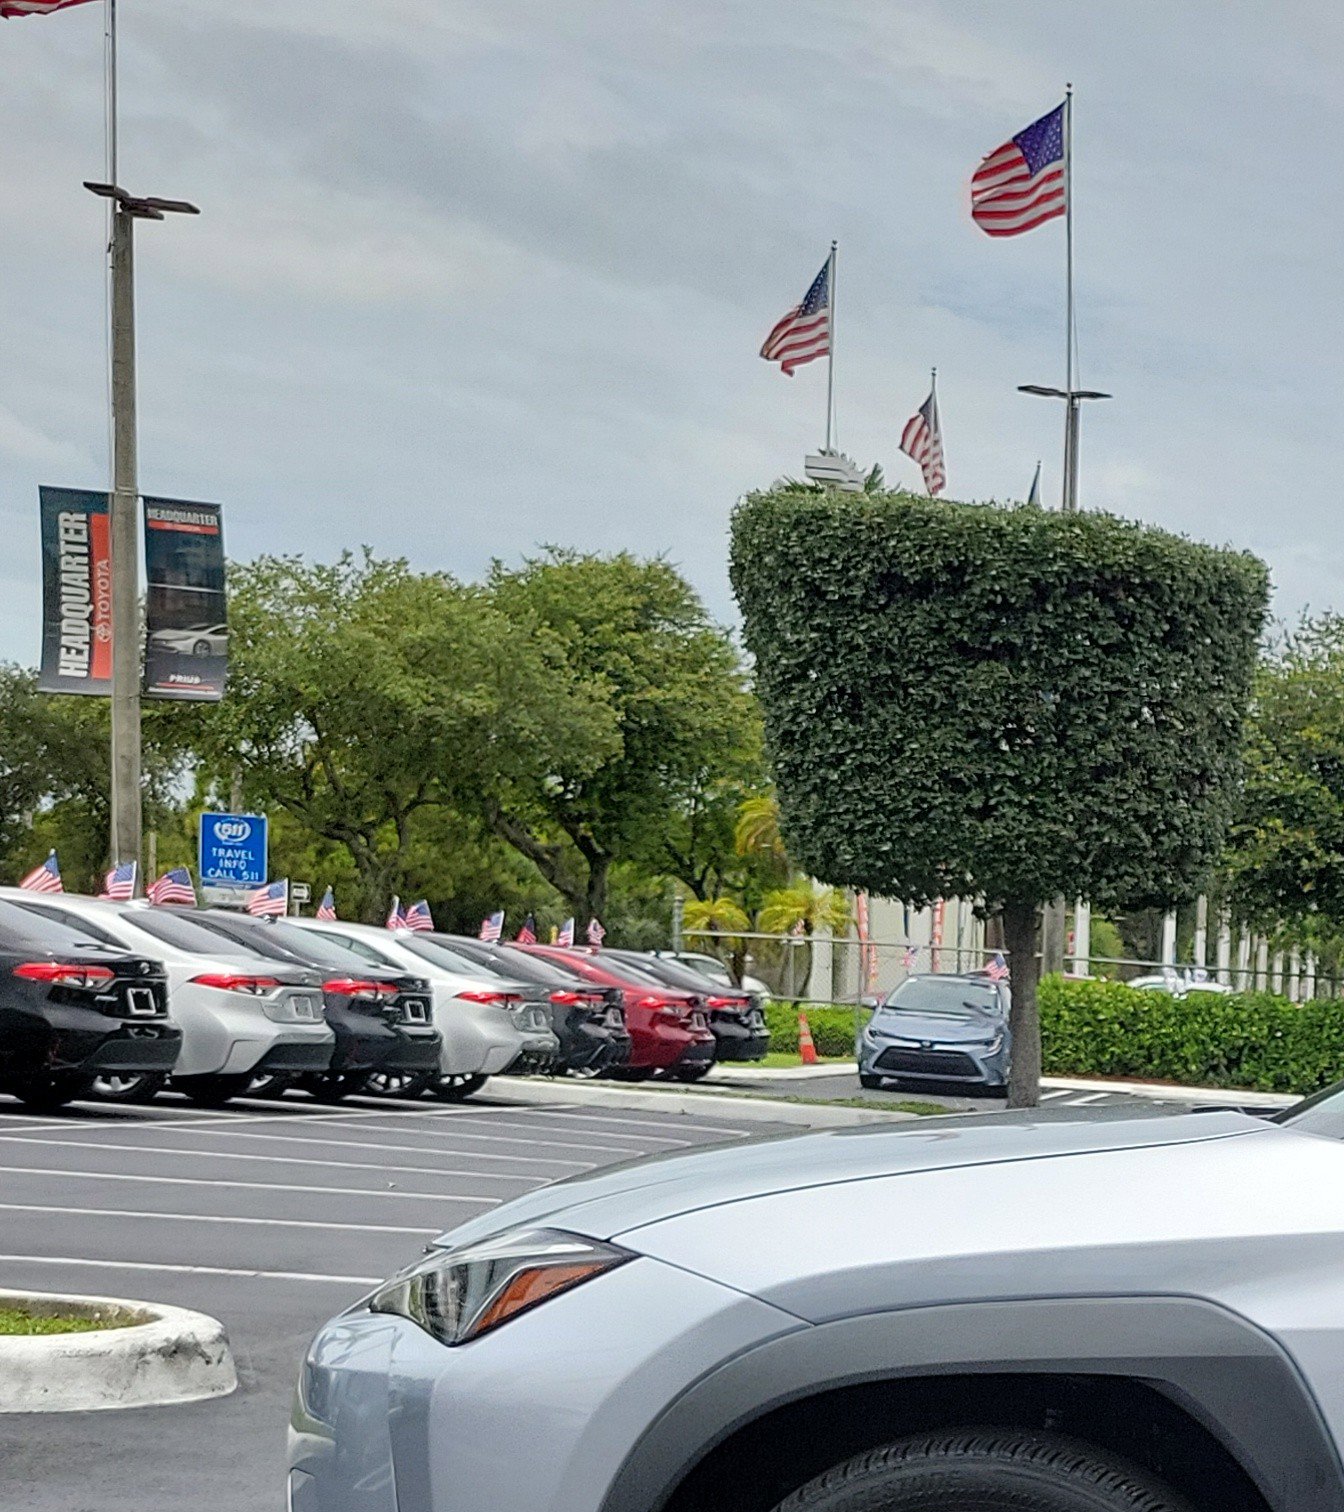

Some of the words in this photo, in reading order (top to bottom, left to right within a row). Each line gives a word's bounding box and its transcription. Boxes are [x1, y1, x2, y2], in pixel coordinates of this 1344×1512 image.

[58, 511, 94, 678] HEADQUARTER
[97, 559, 110, 620] TOYOTA
[212, 847, 255, 861] TRAVEL
[219, 858, 247, 870] INFO
[207, 868, 236, 880] CALL
[241, 871, 259, 880] 511
